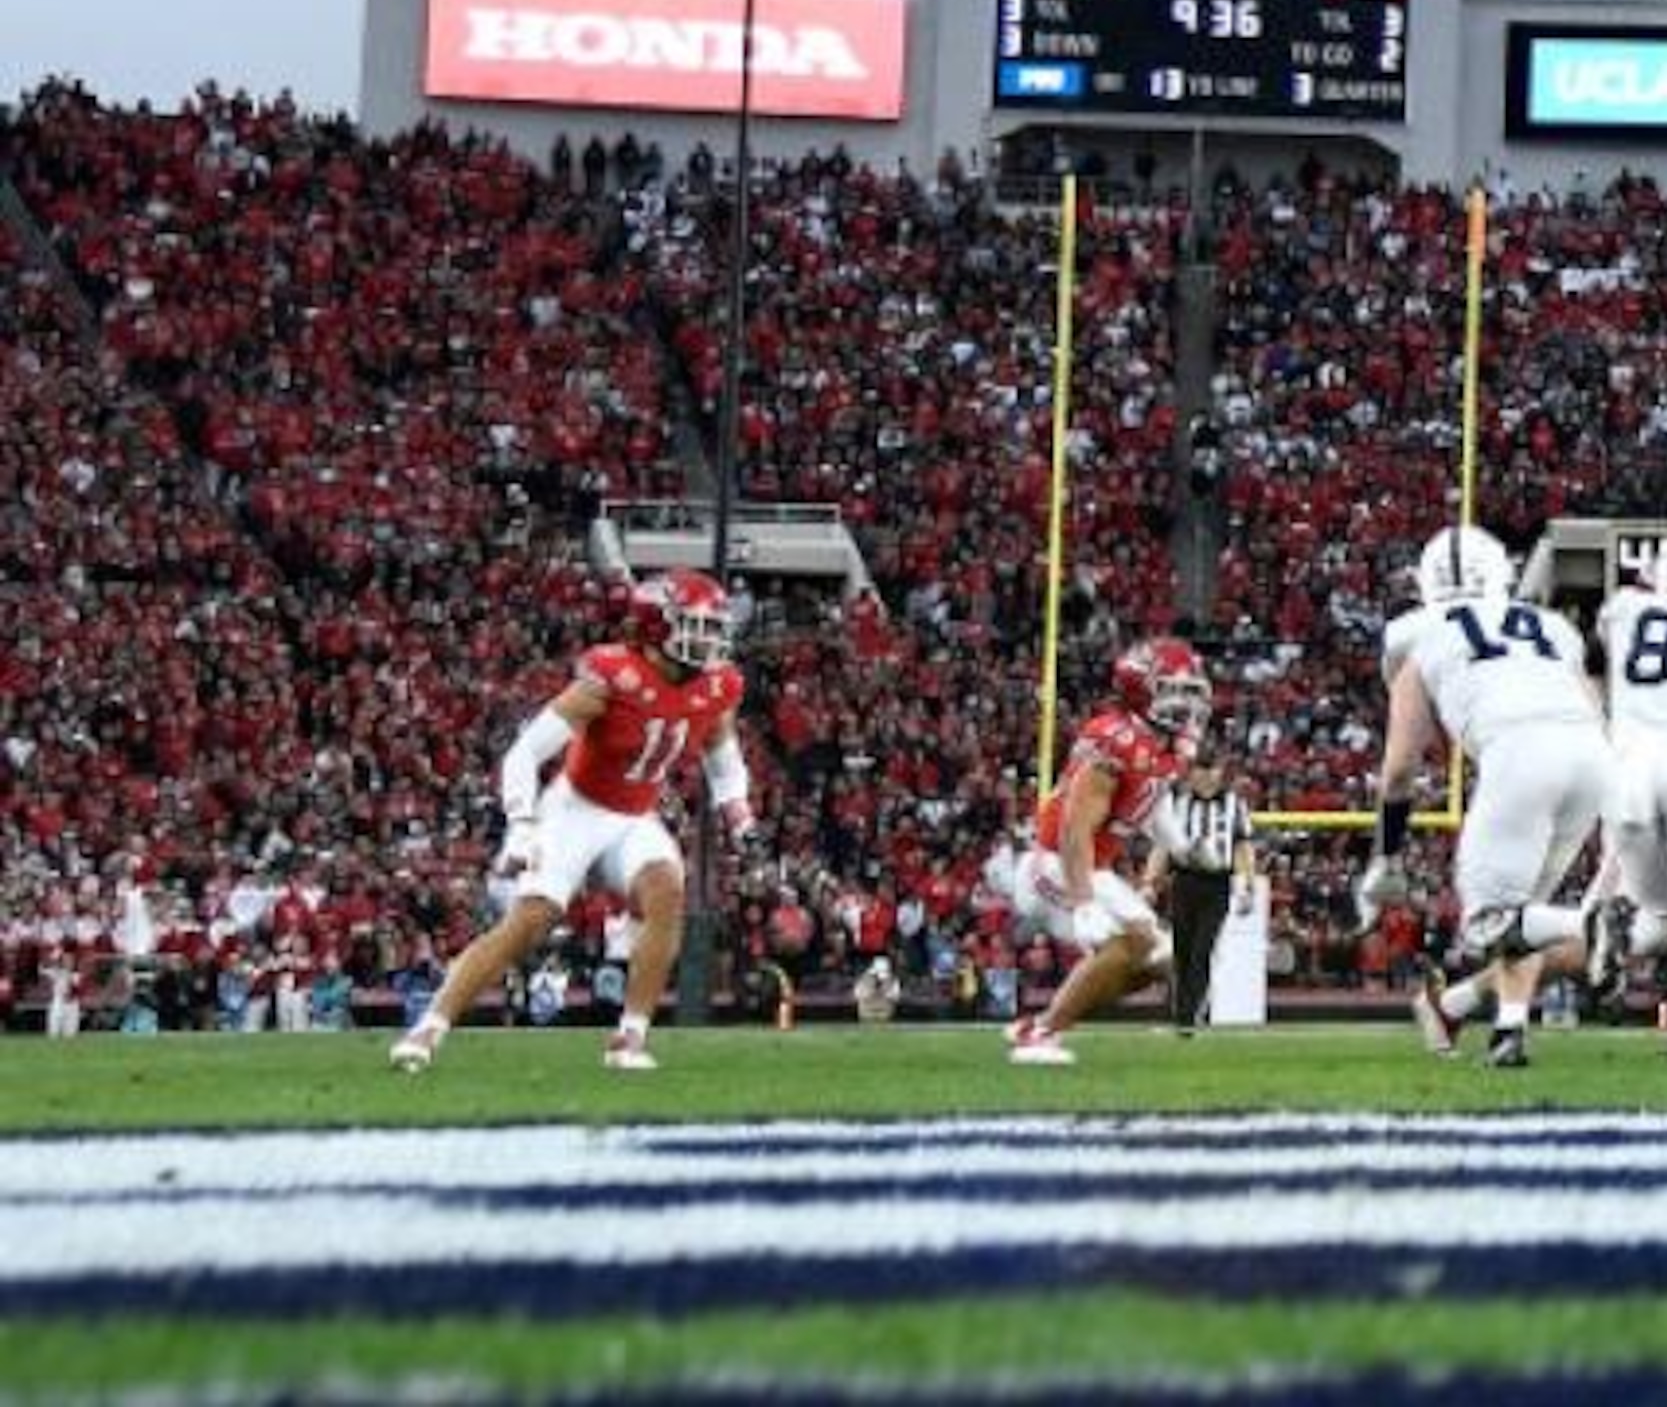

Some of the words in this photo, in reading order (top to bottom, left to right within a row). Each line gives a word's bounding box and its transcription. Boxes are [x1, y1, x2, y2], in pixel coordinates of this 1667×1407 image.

[464, 8, 870, 79] HONDA
[1379, 38, 1402, 72] 2
[1445, 604, 1563, 663] 14
[622, 717, 690, 784] 11
